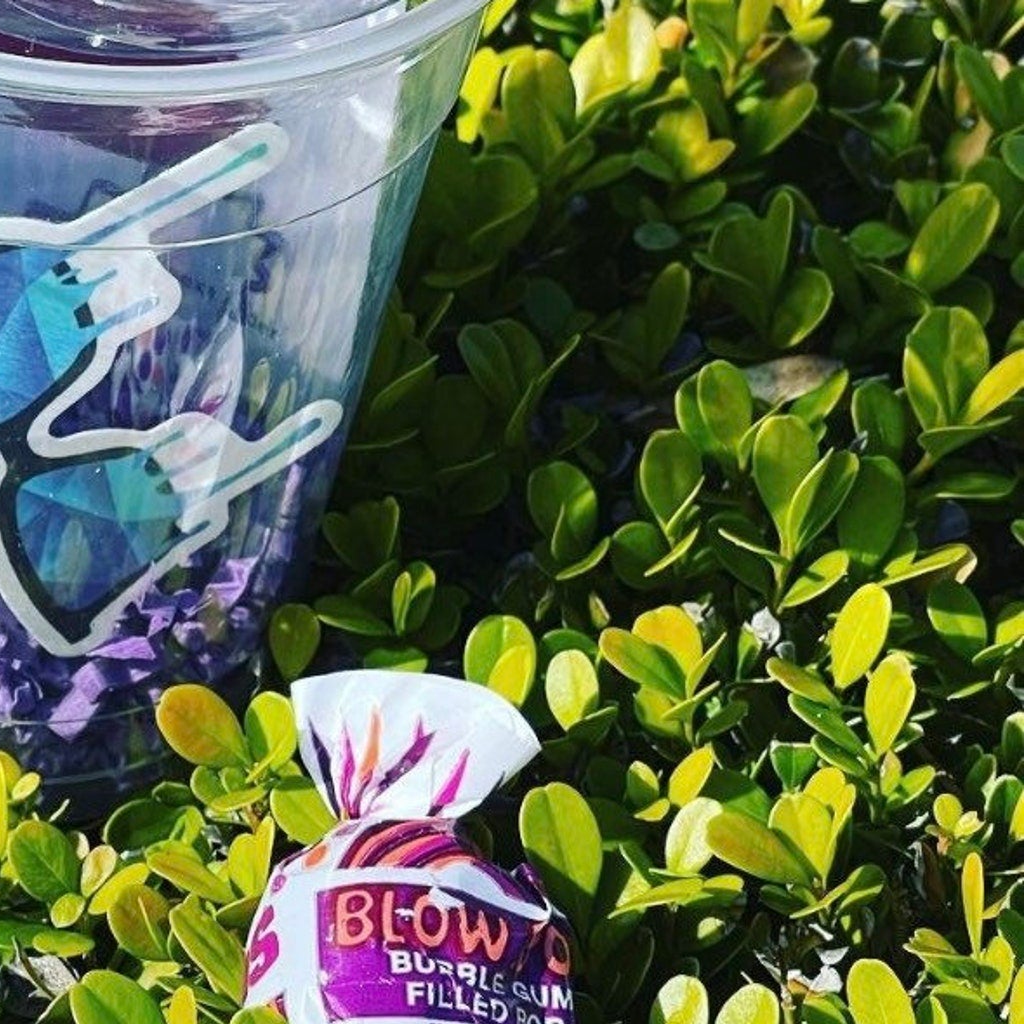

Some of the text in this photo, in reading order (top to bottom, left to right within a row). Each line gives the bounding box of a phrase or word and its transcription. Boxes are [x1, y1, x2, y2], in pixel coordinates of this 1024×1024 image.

[335, 889, 509, 962] BLOW
[389, 949, 574, 1011] BUBBLE GUM
[405, 981, 509, 1024] FILLED
